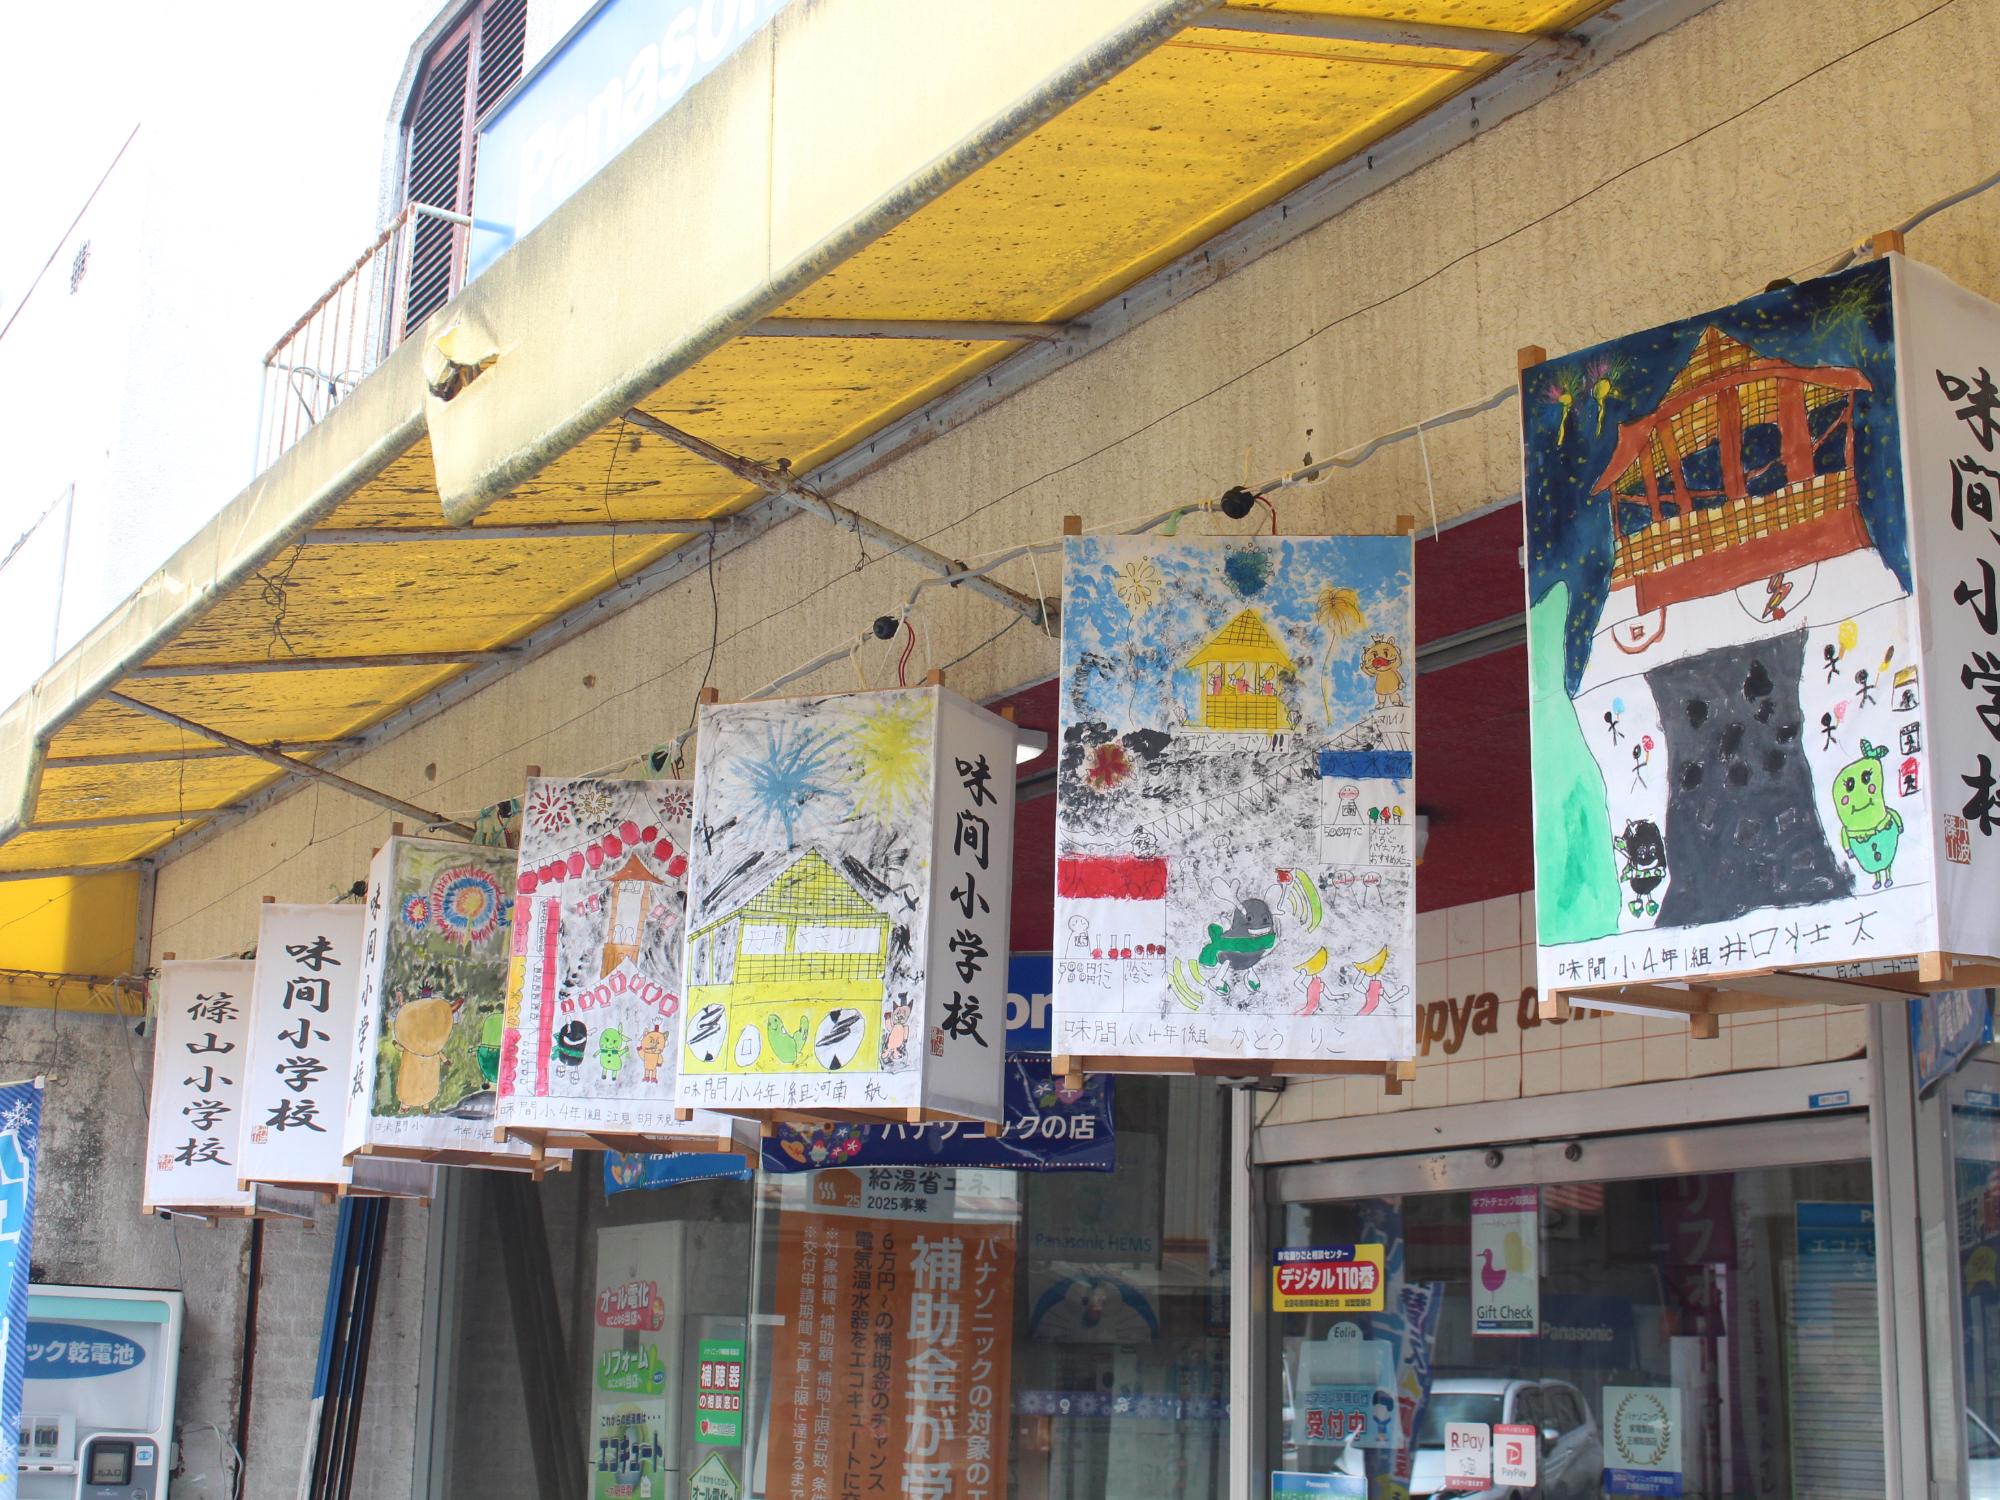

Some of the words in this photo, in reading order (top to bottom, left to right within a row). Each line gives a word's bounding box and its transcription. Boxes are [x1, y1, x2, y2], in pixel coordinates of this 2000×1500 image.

[942, 754, 998, 1048] 味間小学校
[264, 935, 342, 1133] 味間小学校
[173, 992, 237, 1167] 篠山小学校
[868, 1196, 927, 1212] 2025事業
[1108, 1236, 1153, 1252] HEMS
[1281, 1266, 1375, 1291] デジタル110番
[1477, 1306, 1497, 1319] Gift
[1500, 1304, 1533, 1319] Check
[1541, 1322, 1615, 1343] Panasonic
[1462, 1432, 1485, 1452] Pay
